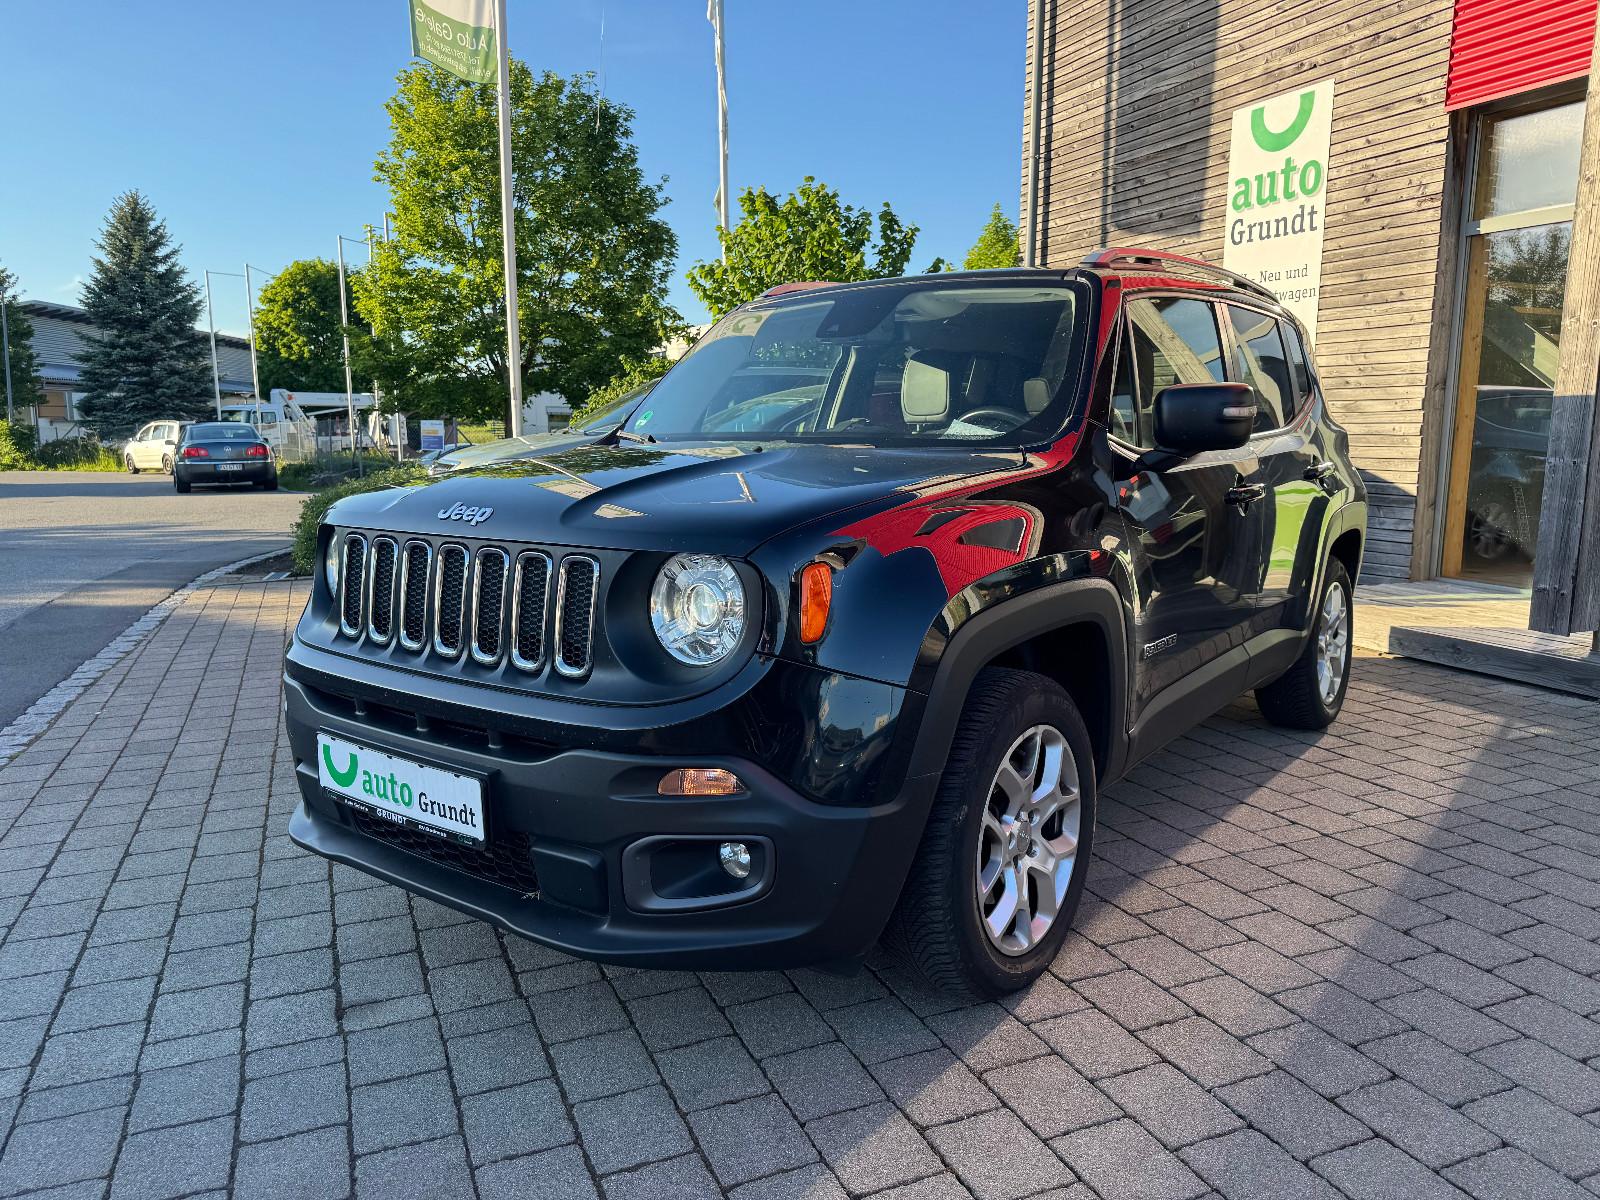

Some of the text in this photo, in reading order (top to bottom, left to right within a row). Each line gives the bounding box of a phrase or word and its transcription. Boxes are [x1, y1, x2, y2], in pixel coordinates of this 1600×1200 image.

[1231, 156, 1323, 211] auto
[1230, 204, 1318, 246] Grundt
[1259, 270, 1281, 283] Neu
[1285, 263, 1308, 280] und
[437, 501, 495, 527] Jeep
[362, 769, 477, 828] auto Grundt
[376, 807, 407, 825] GRUNDT
